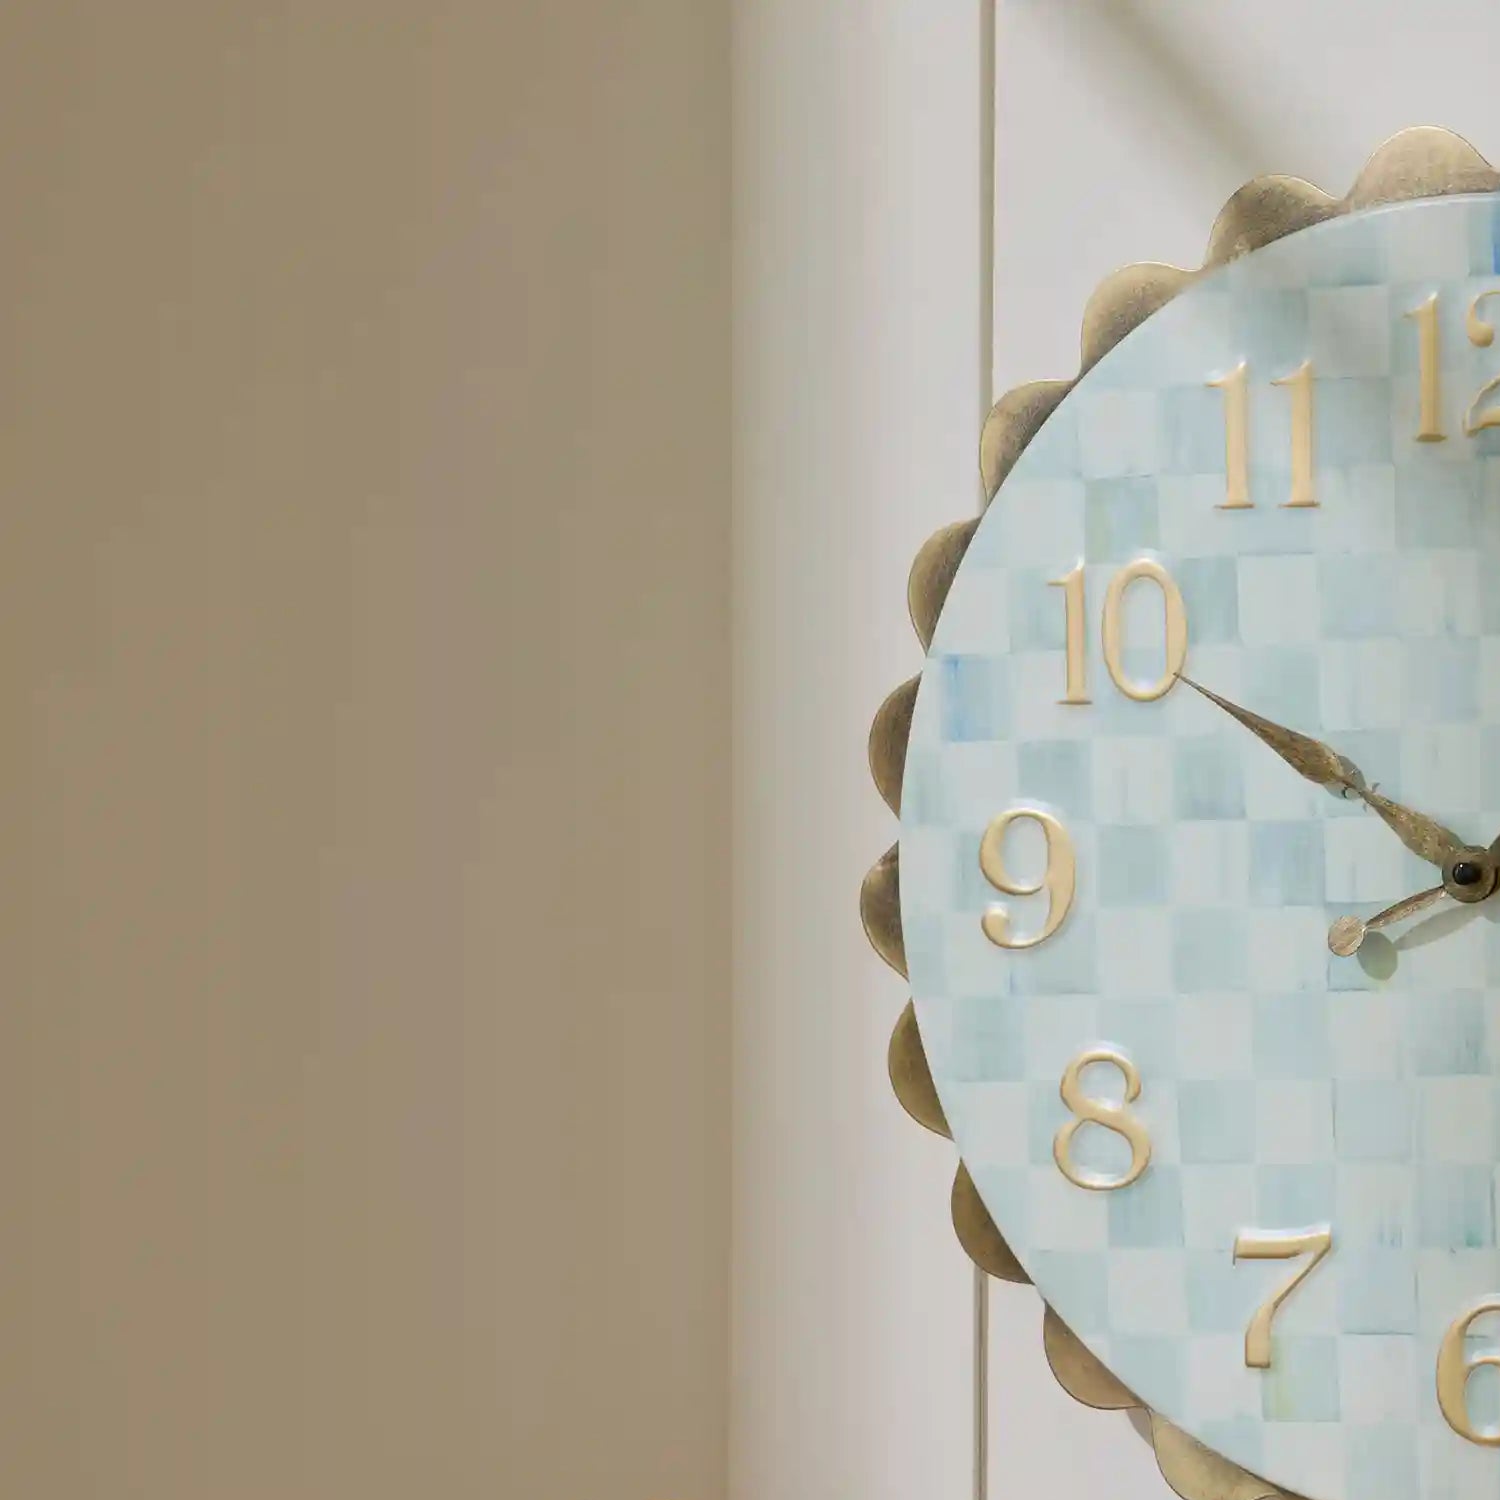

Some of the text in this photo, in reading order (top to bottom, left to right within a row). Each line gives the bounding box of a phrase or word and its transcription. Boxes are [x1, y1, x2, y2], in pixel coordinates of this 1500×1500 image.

[1204, 360, 1319, 508] 11
[1048, 560, 1187, 706] 10
[980, 808, 1075, 948] 9
[1055, 1052, 1151, 1190] 8
[1233, 1231, 1332, 1369] 7
